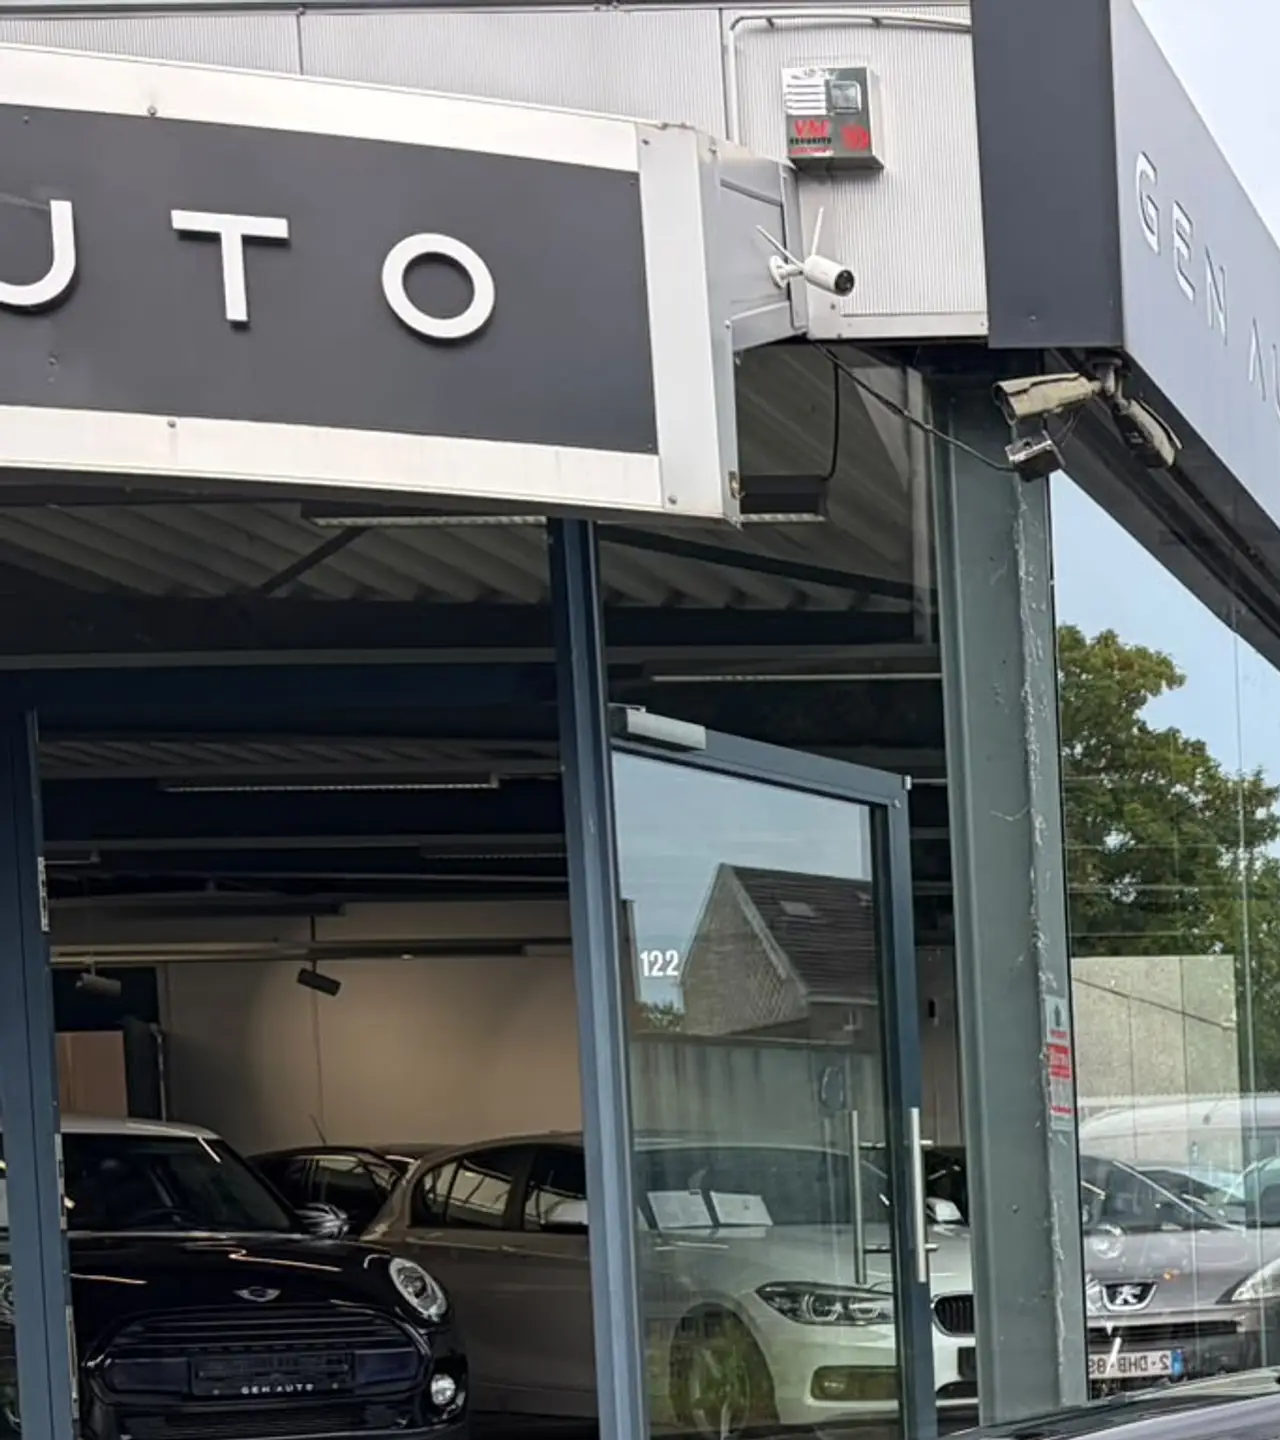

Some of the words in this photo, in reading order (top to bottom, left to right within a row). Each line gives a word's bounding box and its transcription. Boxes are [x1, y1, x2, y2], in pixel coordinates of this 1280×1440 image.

[1136, 150, 1228, 338] GEN
[639, 949, 679, 977] 122
[275, 1383, 314, 1393] AUTO
